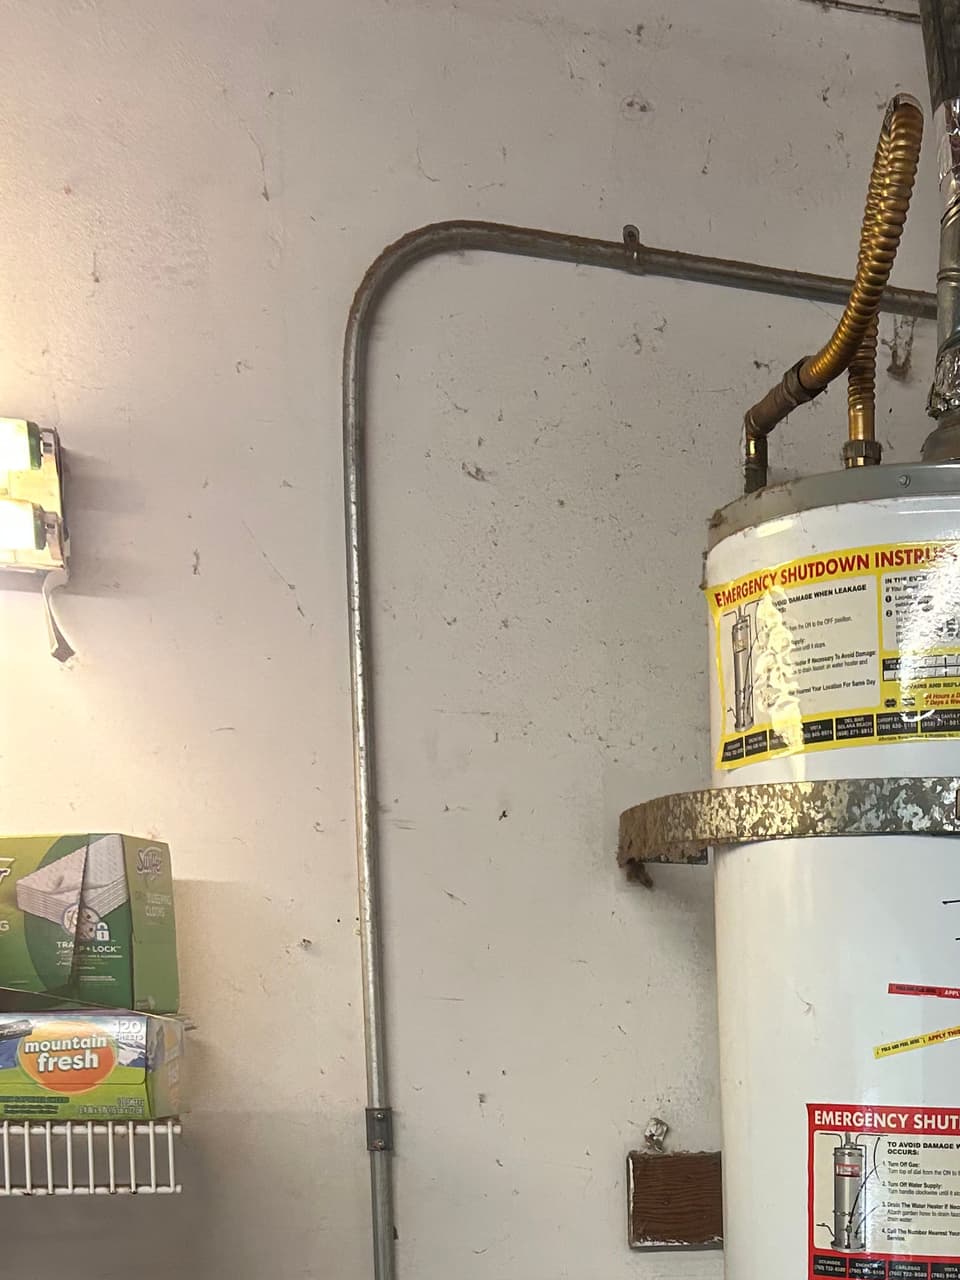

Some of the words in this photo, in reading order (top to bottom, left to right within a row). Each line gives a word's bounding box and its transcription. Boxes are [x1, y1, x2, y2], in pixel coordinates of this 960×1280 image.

[714, 572, 778, 608] EMERGENCY
[780, 552, 869, 586] SHUTDOWN
[788, 592, 812, 604] DAMAGE
[813, 588, 833, 598] WHEN
[834, 584, 867, 595] LEAKAGE
[114, 1020, 141, 1033] 120
[24, 1034, 107, 1054] mountain
[927, 1032, 947, 1042] APPLY
[38, 1051, 99, 1073] fresh
[814, 1110, 909, 1128] EMERGENCY
[887, 1148, 919, 1156] OCCURS:
